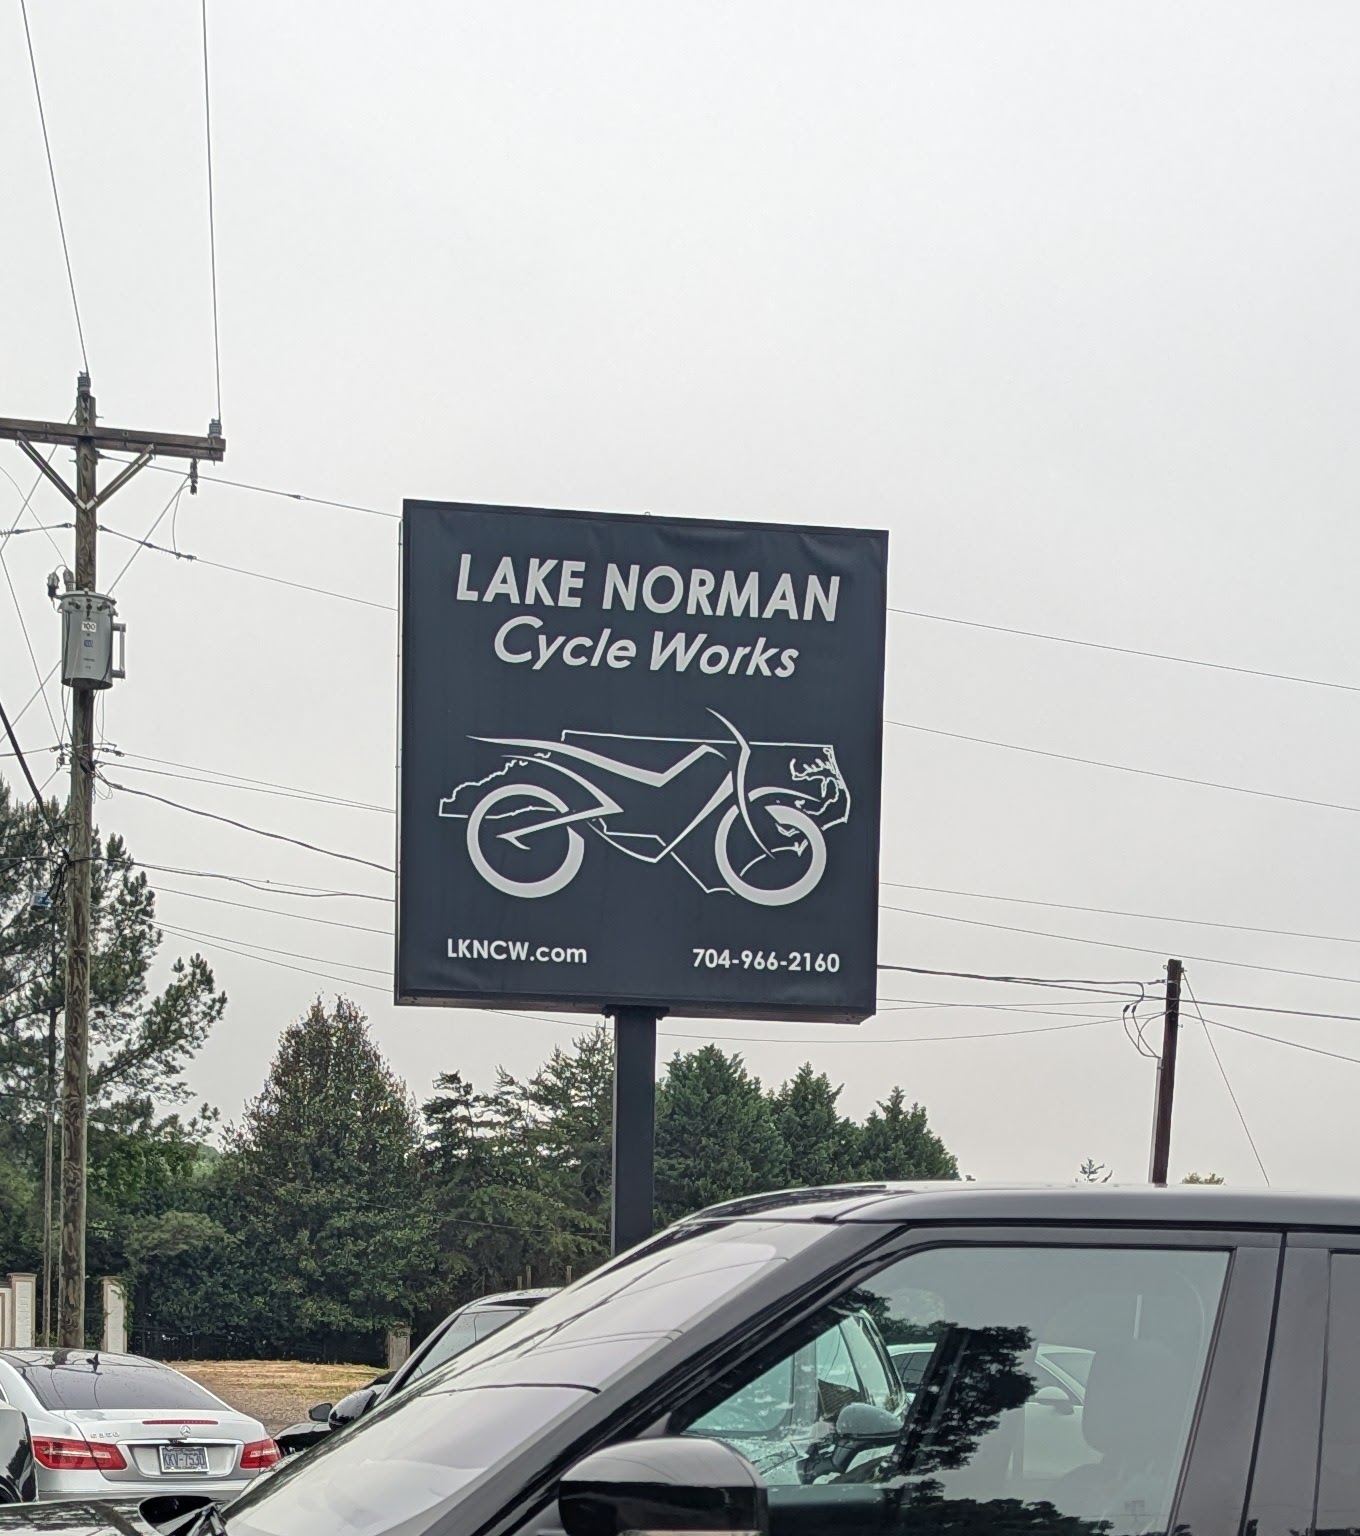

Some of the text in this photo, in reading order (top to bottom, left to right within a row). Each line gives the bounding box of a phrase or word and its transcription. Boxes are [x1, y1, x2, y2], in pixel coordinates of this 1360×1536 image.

[456, 553, 840, 622] LAKE NORMAN
[494, 615, 800, 678] Cycle Works
[446, 938, 588, 964] LKNCW.com
[692, 948, 840, 973] 704-966-2160
